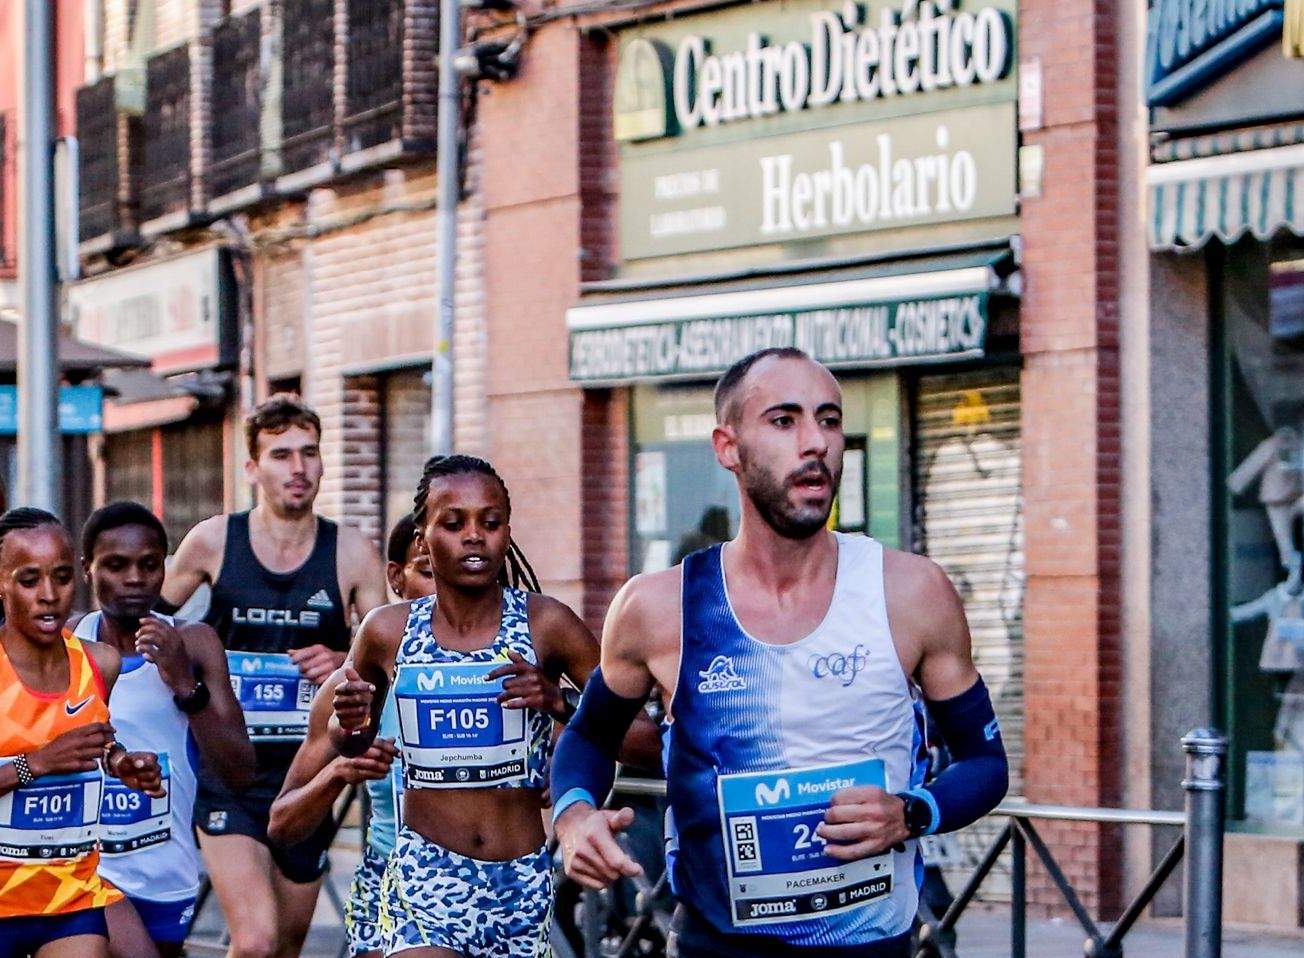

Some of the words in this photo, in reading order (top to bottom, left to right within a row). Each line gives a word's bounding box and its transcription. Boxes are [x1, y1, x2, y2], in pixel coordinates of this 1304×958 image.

[674, 32, 809, 128] Centro
[760, 125, 977, 234] Herbolario
[254, 684, 284, 701] 155
[430, 708, 489, 730] F105
[440, 754, 483, 762] Jepchumba
[491, 765, 521, 778] MADRID
[798, 777, 856, 795] Movistar
[24, 793, 71, 815] F101
[786, 873, 845, 889] PACEMAKER
[850, 882, 886, 899] MADRID
